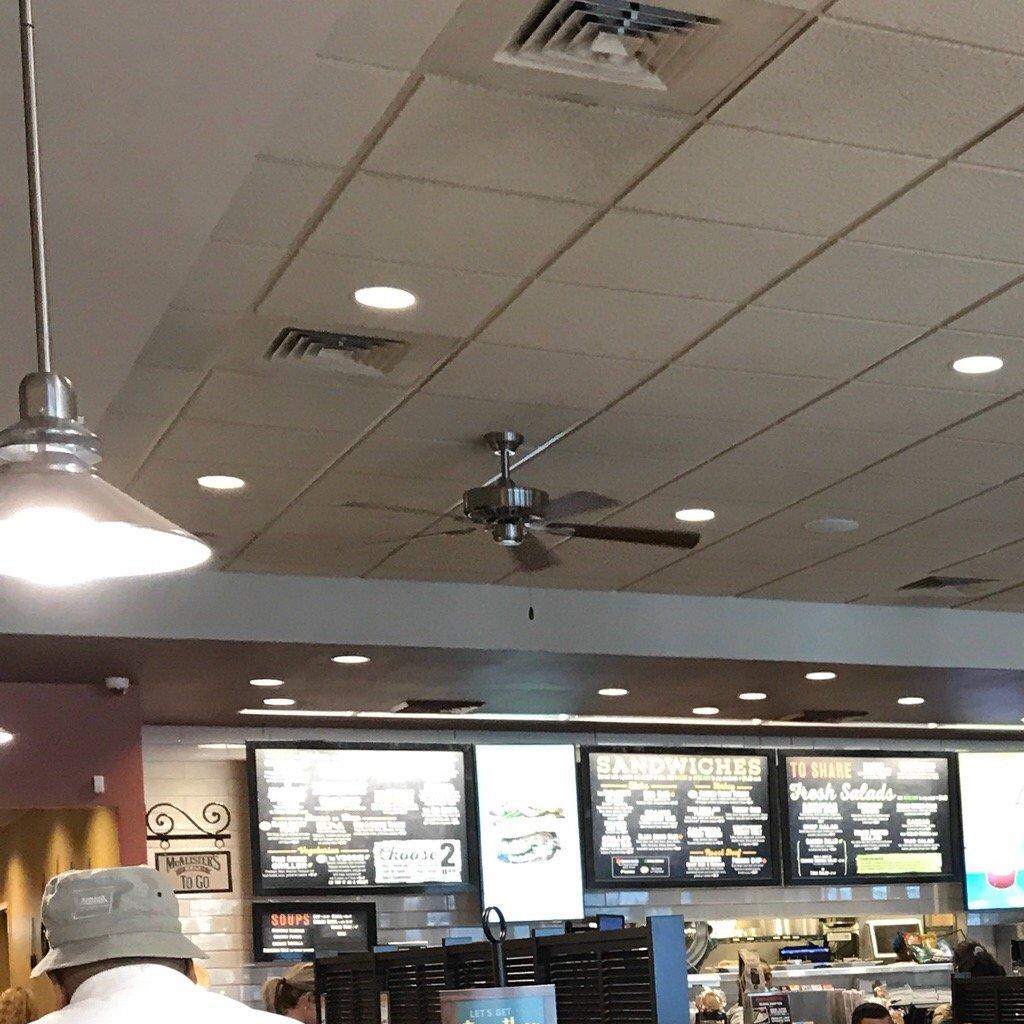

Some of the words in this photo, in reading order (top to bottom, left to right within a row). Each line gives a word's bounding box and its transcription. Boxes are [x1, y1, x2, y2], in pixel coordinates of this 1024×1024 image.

[596, 755, 762, 775] SANDWICHES
[790, 762, 807, 778] TO
[810, 761, 853, 779] SHARE
[789, 782, 837, 801] Fresh
[840, 782, 897, 801] Salads
[380, 846, 437, 861] Choose
[441, 842, 456, 867] 2
[271, 913, 310, 926] SOUPS
[470, 1008, 493, 1018] LET'S
[495, 1007, 512, 1016] GET
